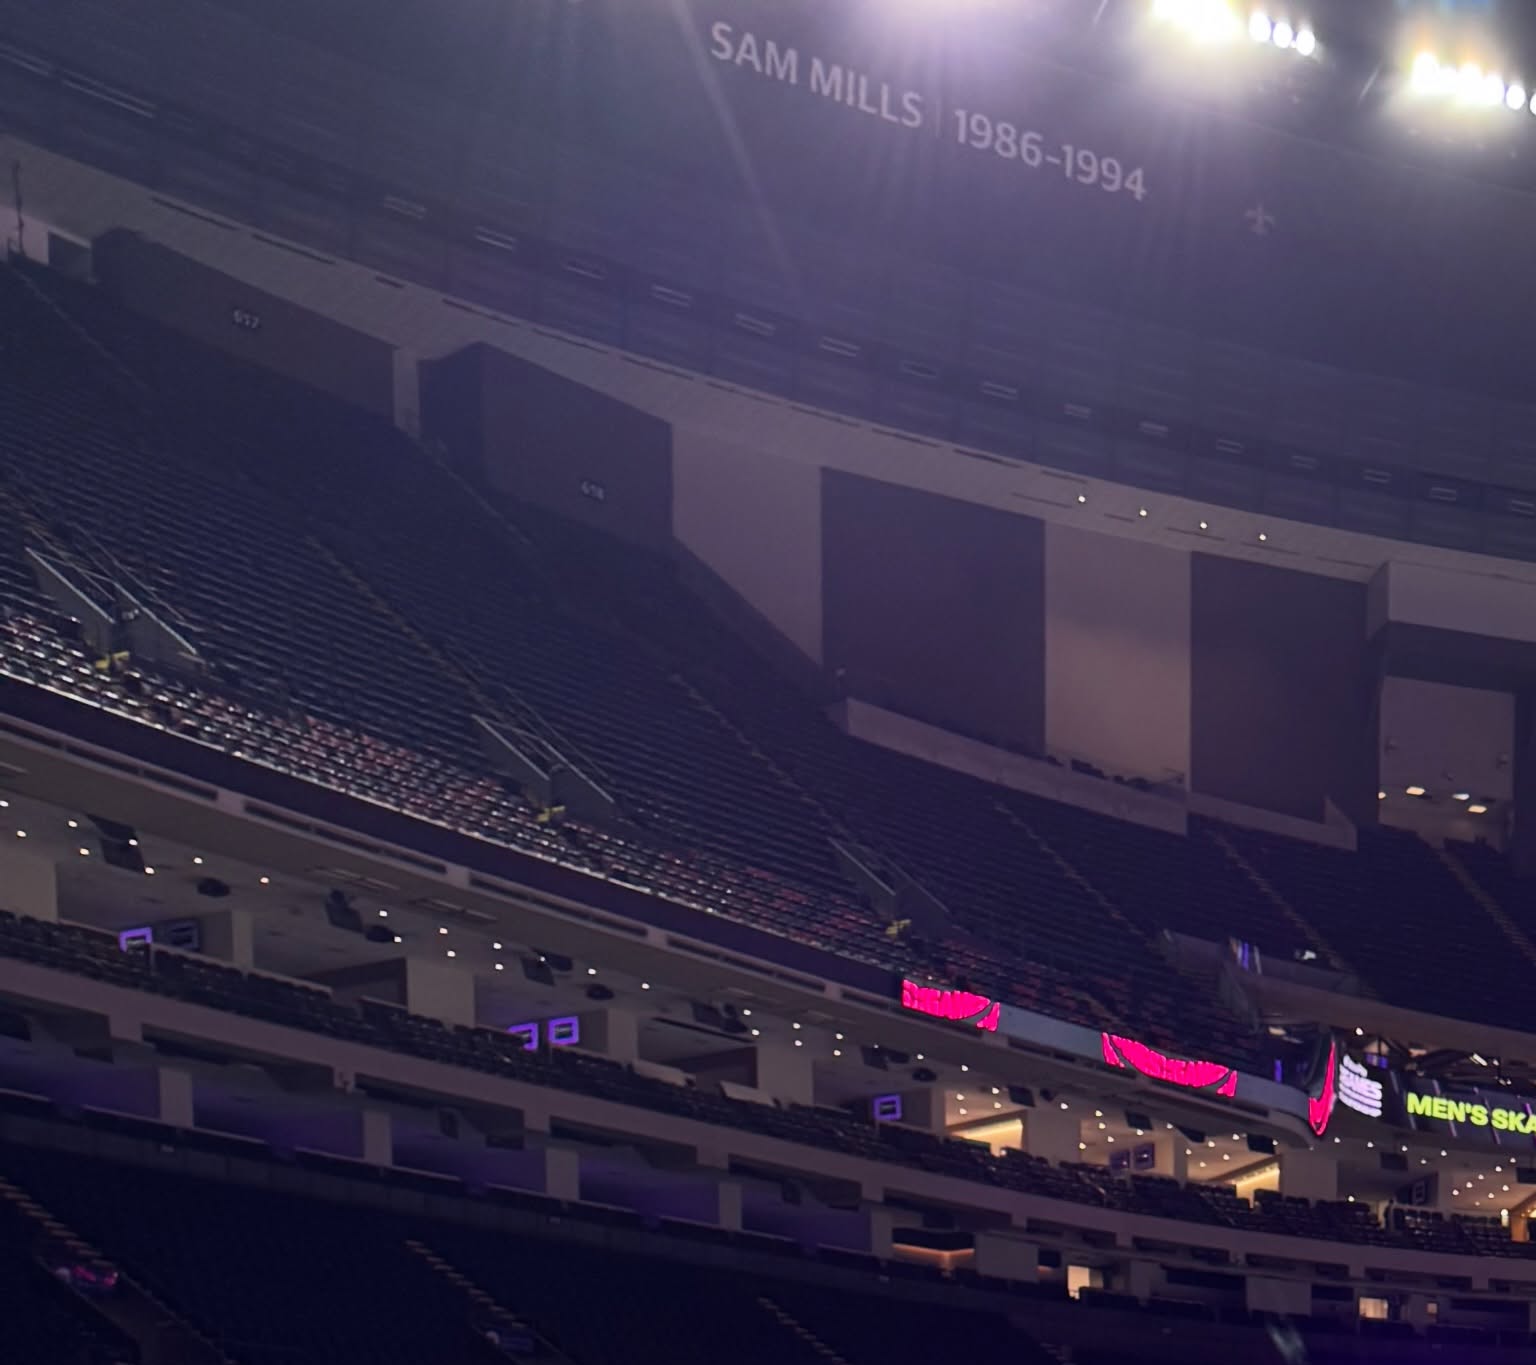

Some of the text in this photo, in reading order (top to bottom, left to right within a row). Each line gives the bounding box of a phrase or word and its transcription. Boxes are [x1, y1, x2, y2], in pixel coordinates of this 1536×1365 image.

[710, 19, 1148, 202] SAM MILLS 1986-1994
[1406, 1093, 1488, 1127] MEN'S
